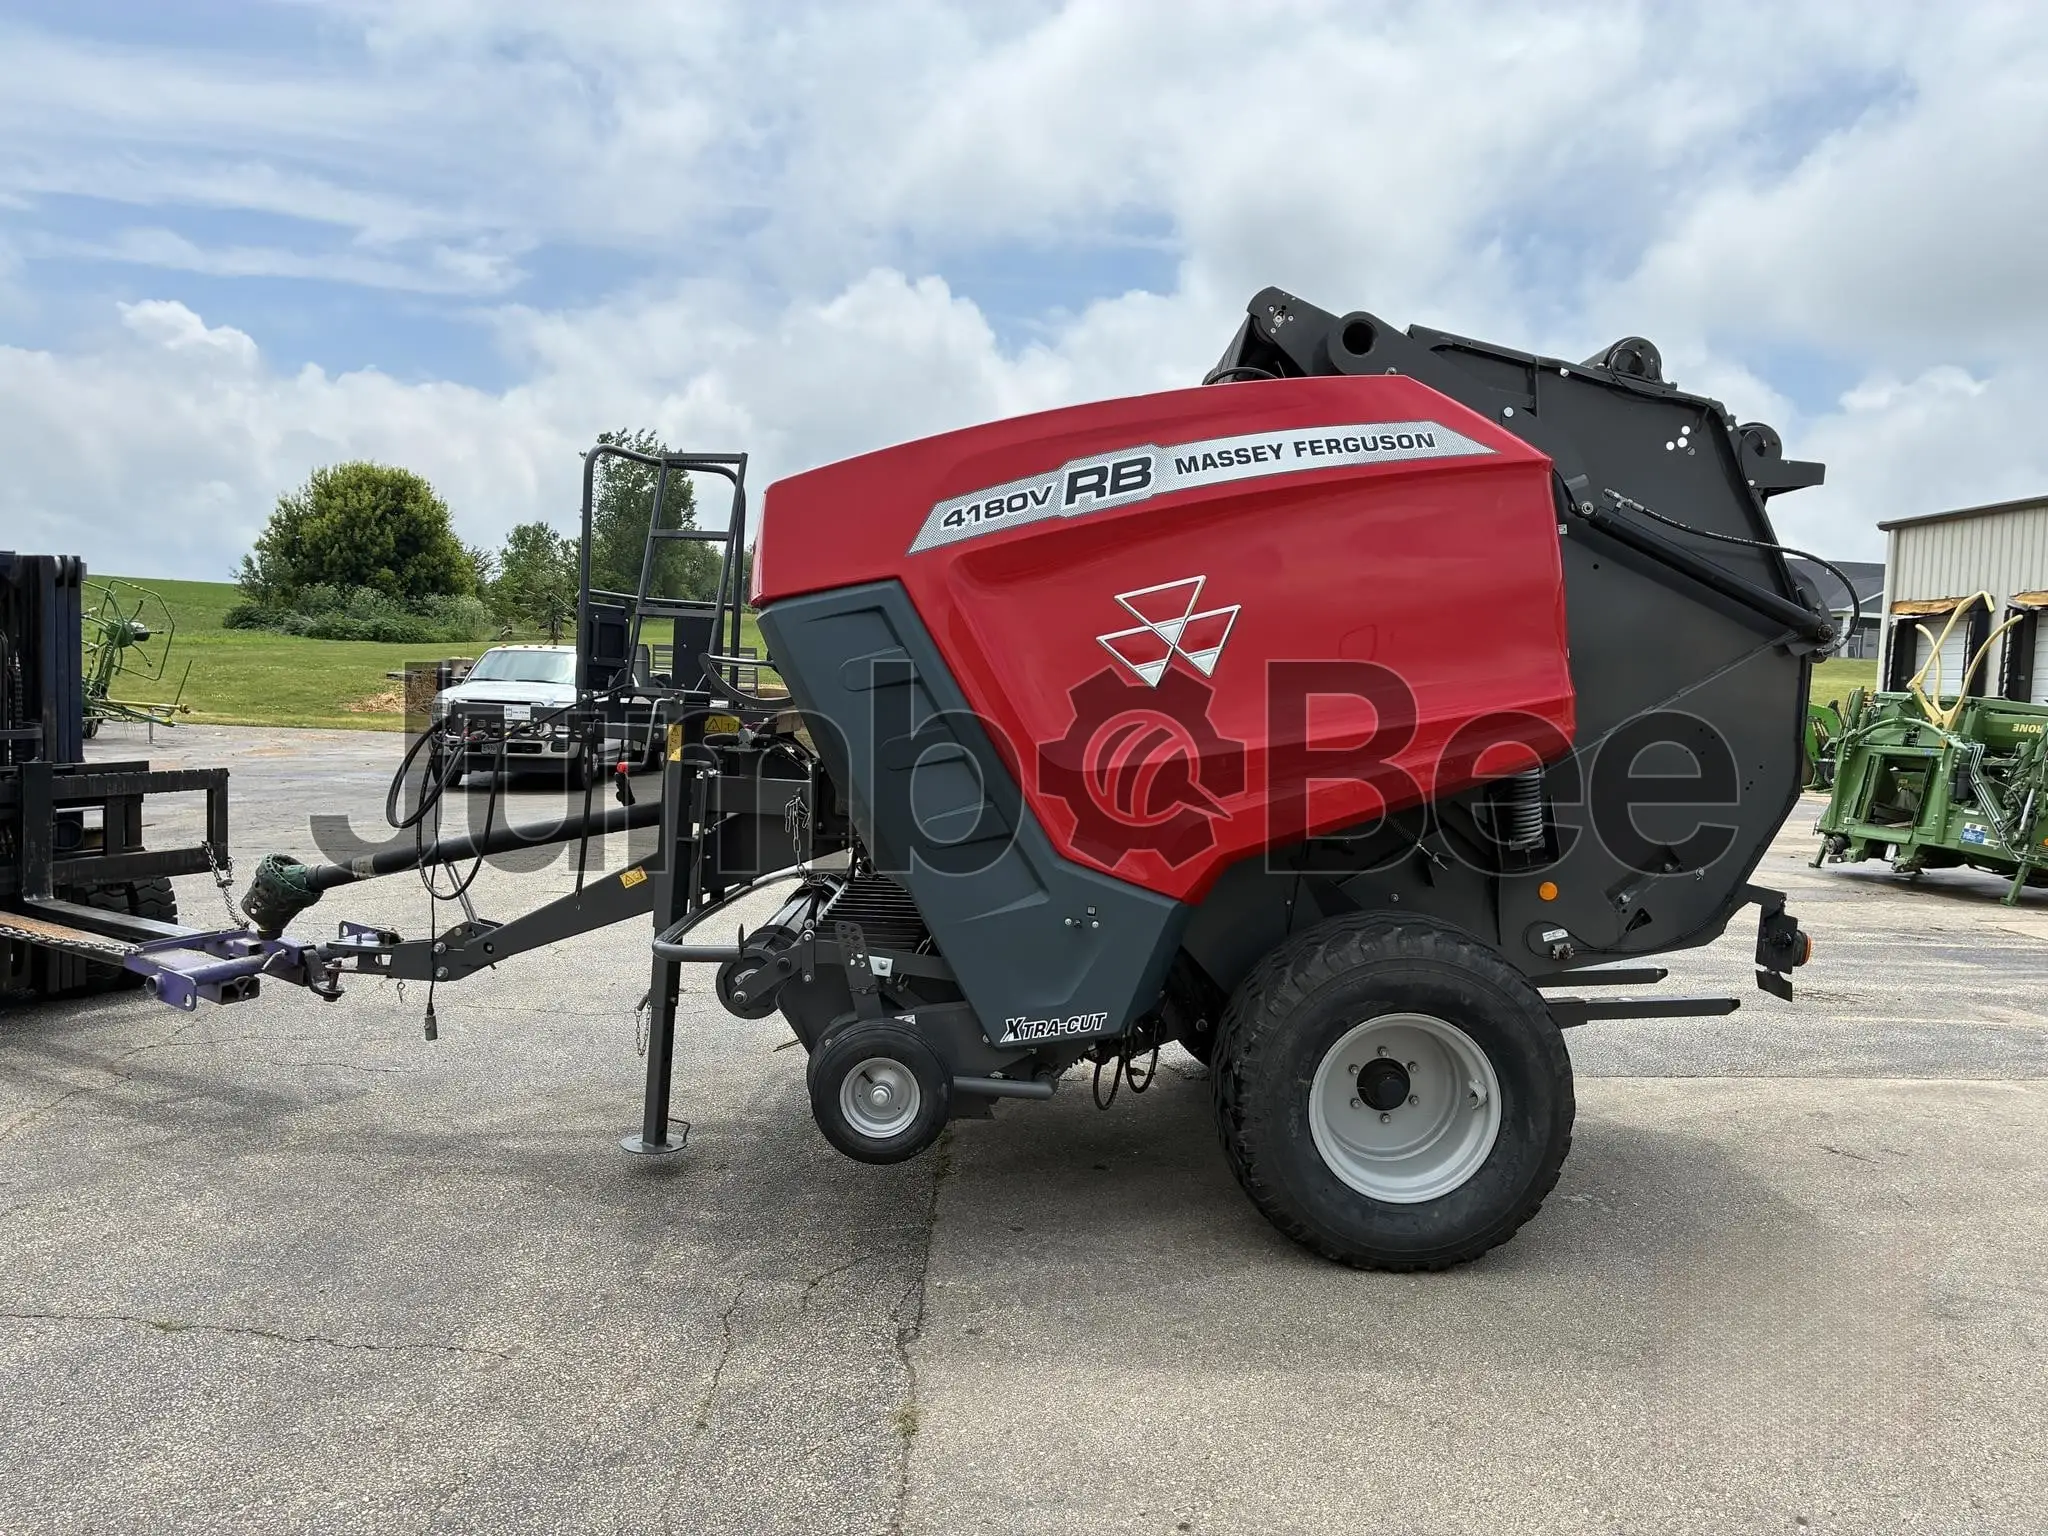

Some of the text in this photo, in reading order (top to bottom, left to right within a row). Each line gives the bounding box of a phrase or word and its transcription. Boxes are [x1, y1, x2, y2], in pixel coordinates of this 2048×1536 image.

[943, 432, 1436, 528] 4180V RB MASSEY FERGUSON
[2011, 723, 2044, 734] RONE
[1000, 1012, 1108, 1043] XTRA-CUT
